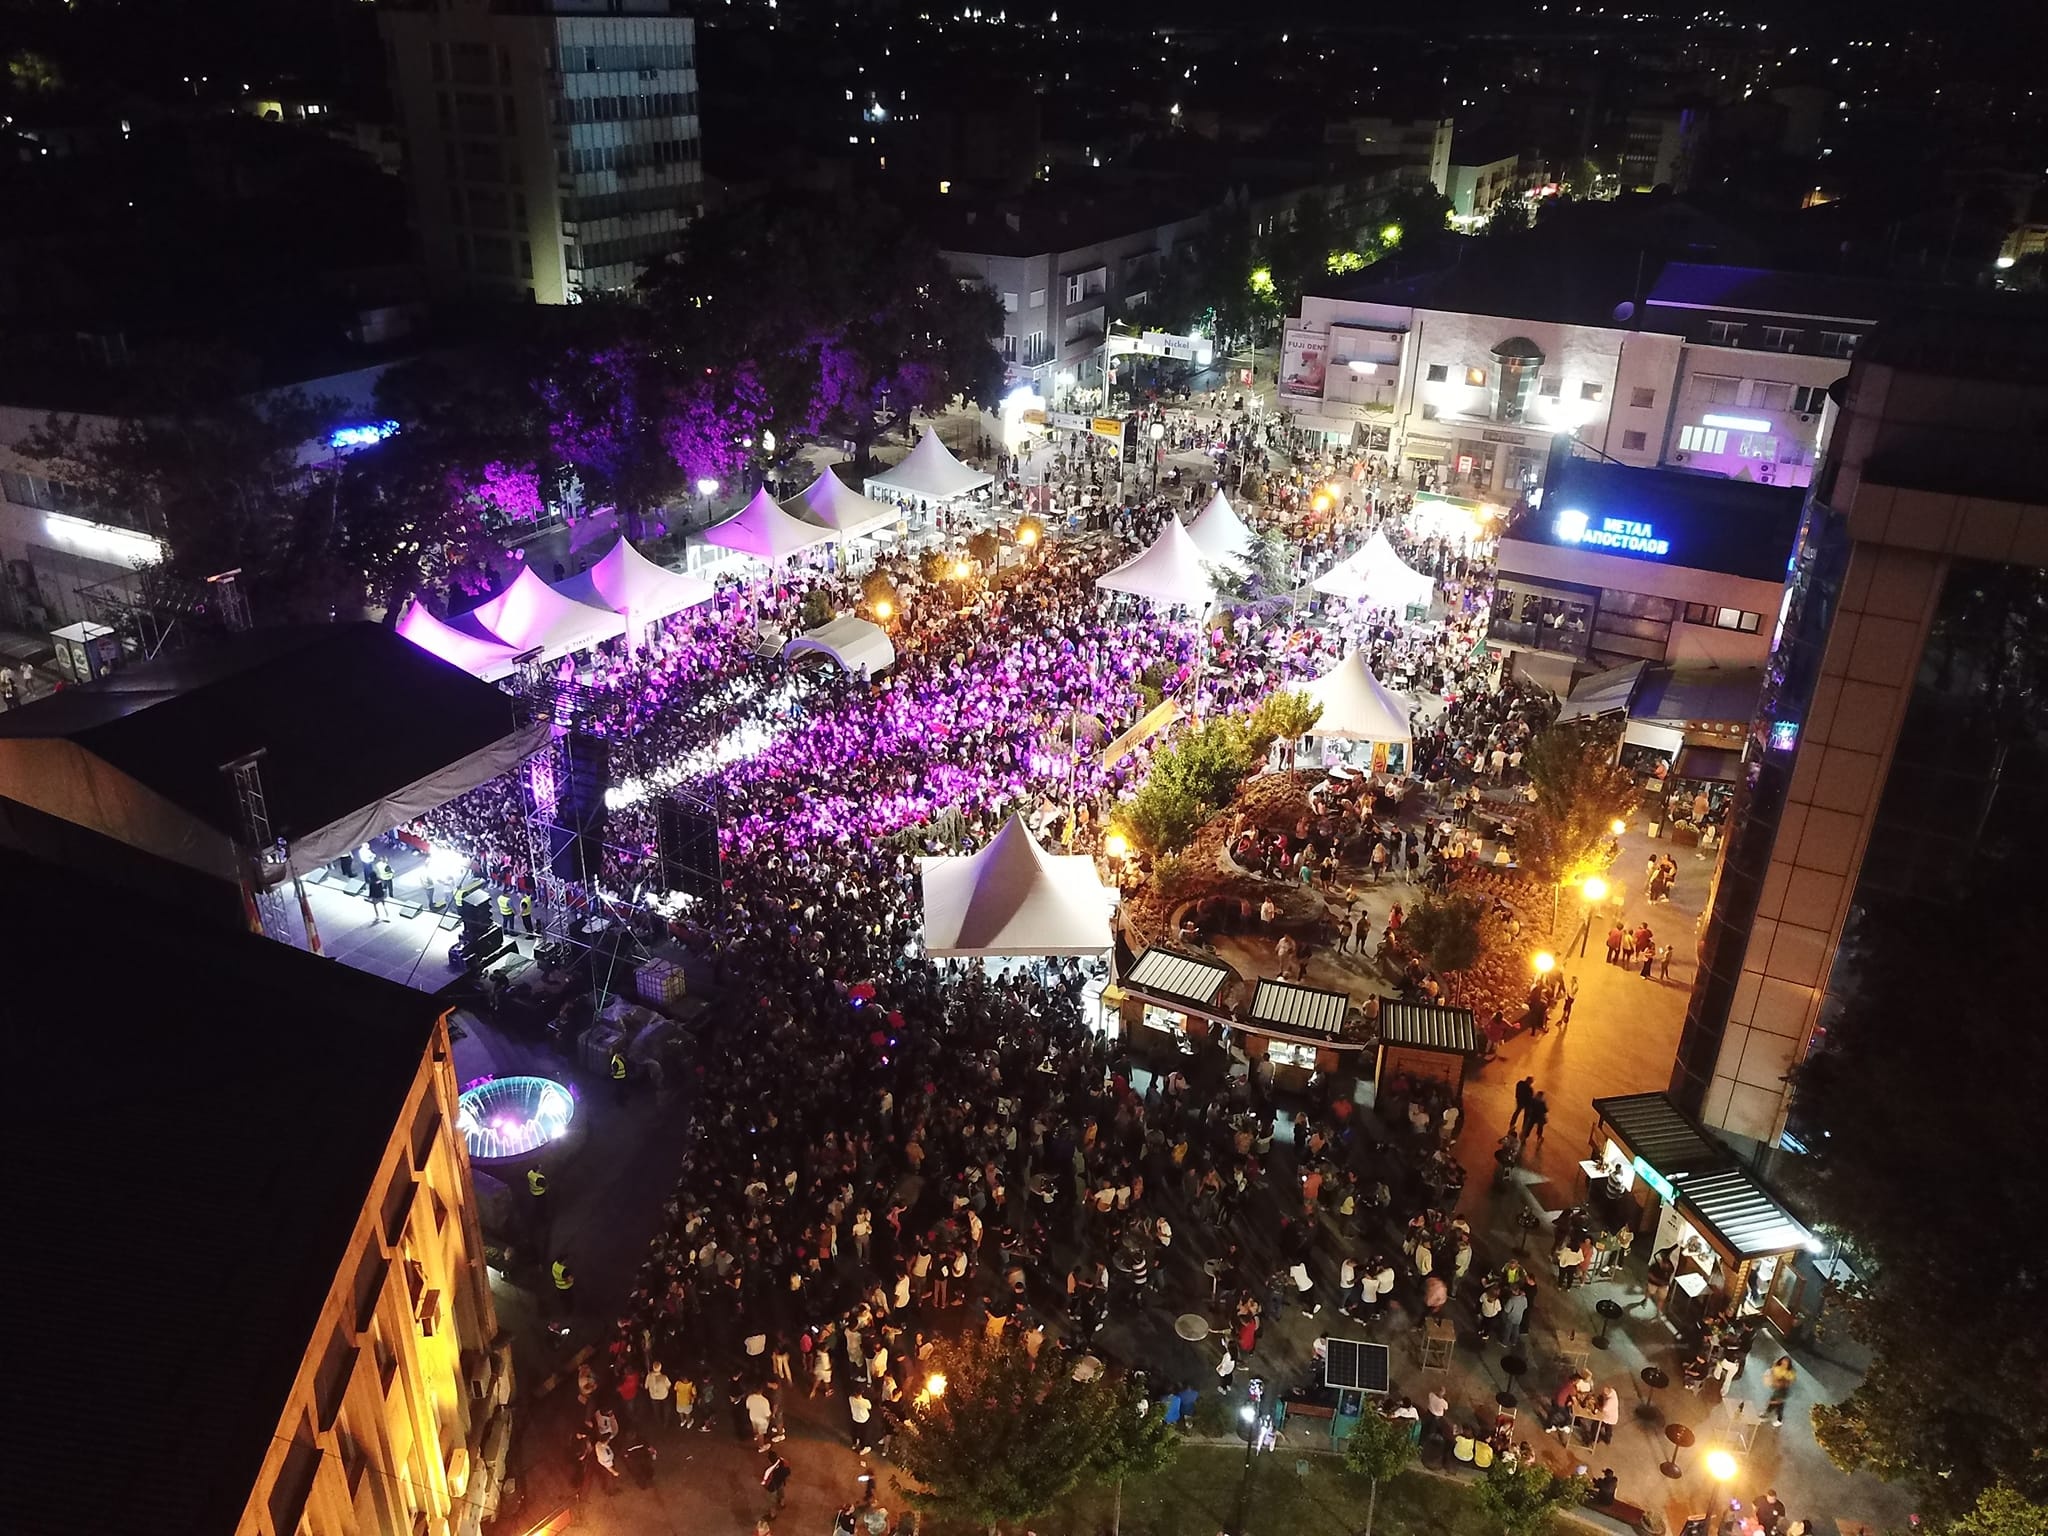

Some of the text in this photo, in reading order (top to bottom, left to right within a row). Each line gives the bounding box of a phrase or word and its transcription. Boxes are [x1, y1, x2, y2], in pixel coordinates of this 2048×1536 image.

[1164, 339, 1190, 350] Nickel
[1288, 341, 1328, 351] FUJI DENT
[1602, 517, 1652, 538] МЕТАЛ
[1583, 529, 1669, 554] АПОСТОЛОВ
